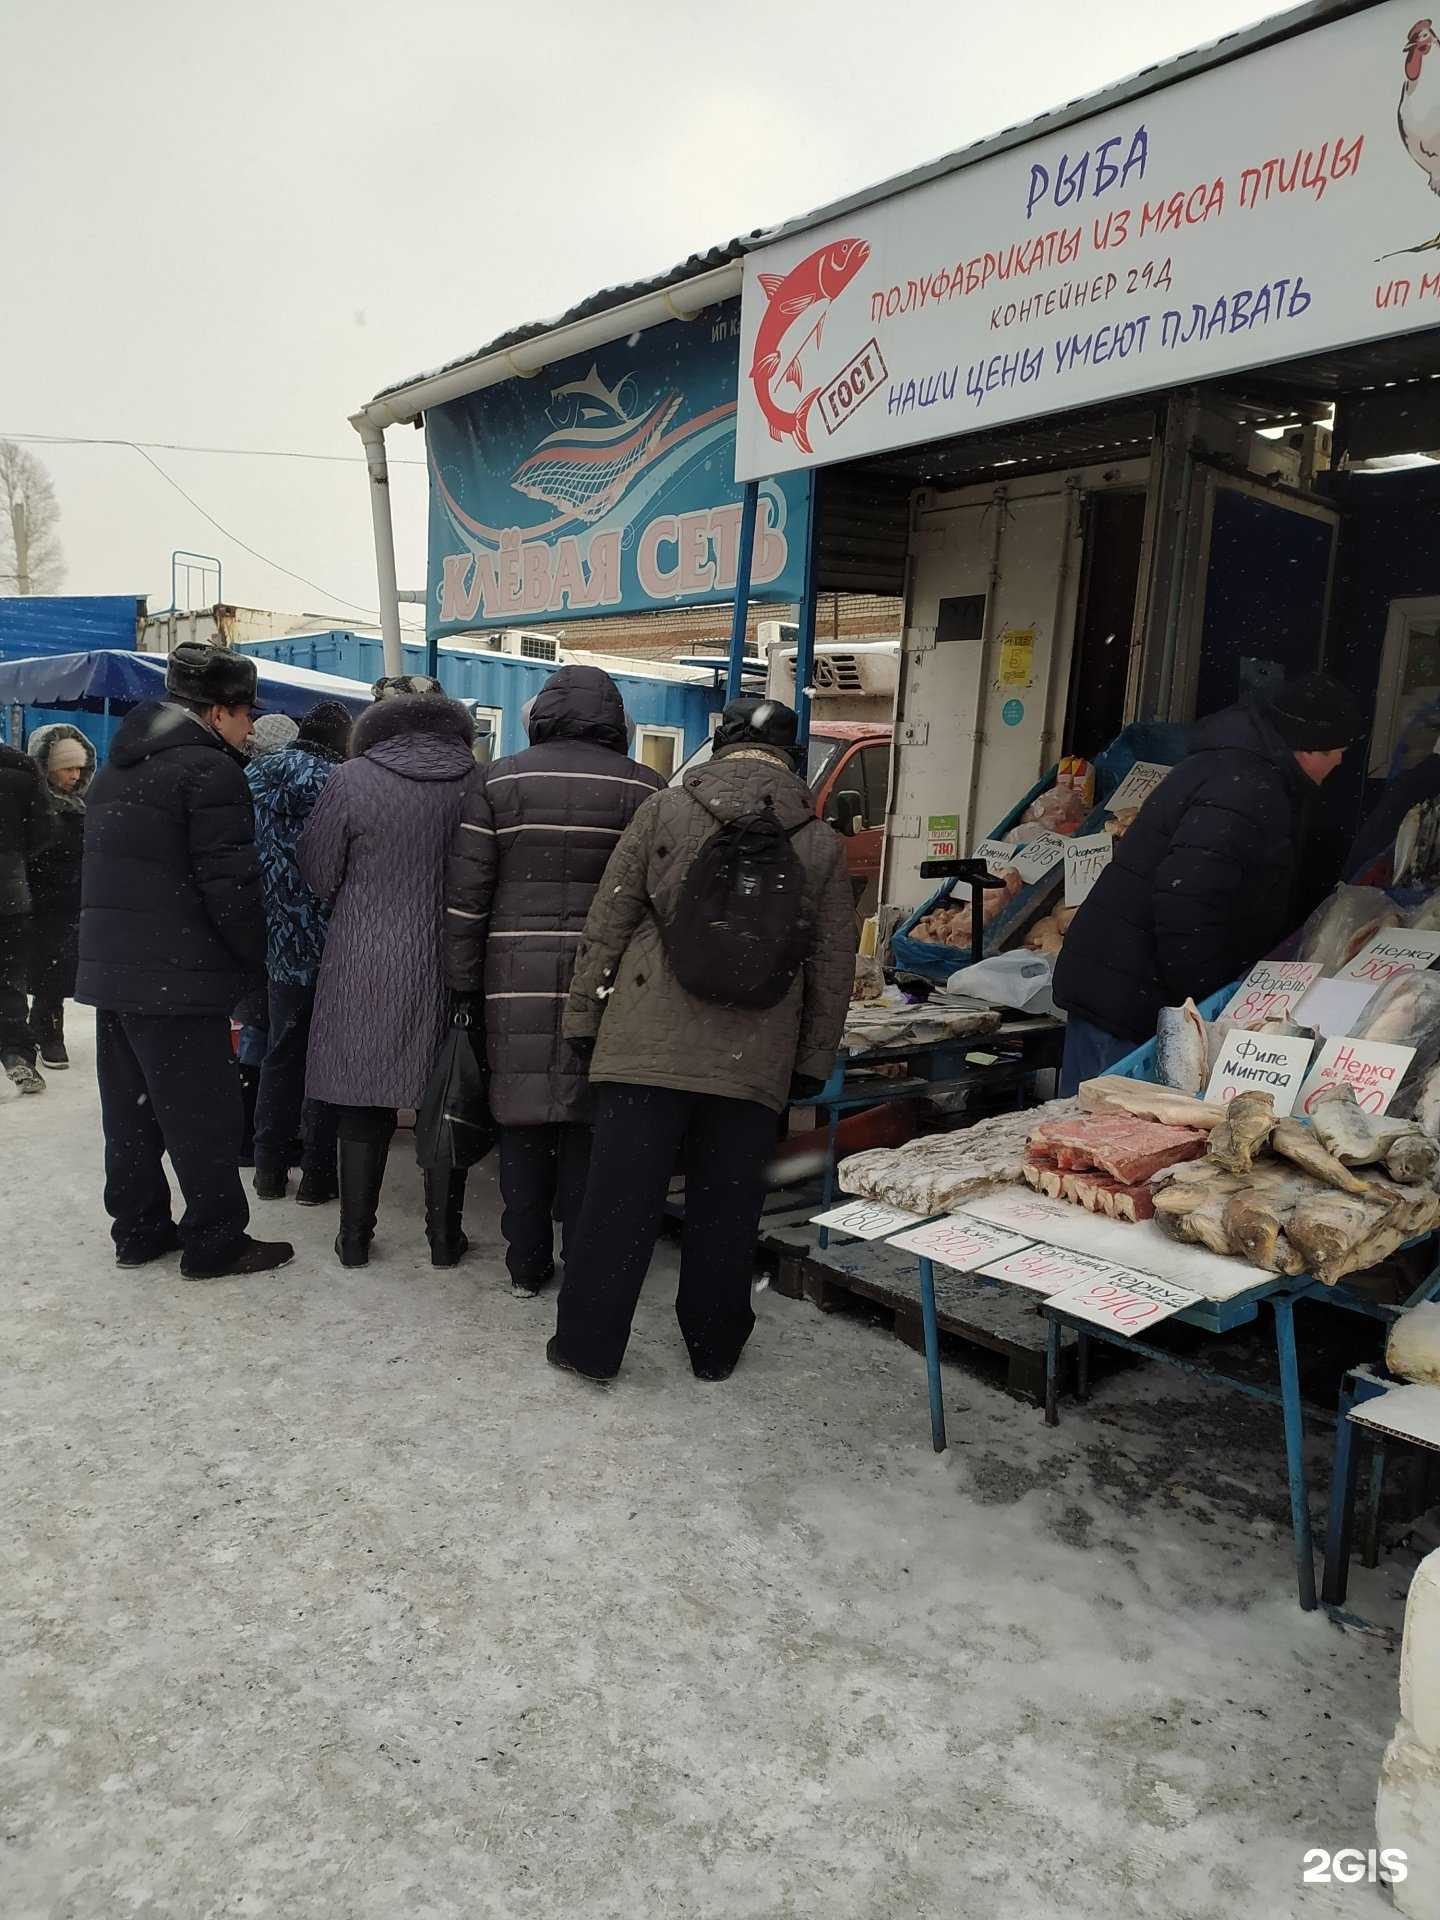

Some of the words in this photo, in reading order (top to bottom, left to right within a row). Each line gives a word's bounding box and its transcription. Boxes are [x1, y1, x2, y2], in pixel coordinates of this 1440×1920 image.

[1026, 125, 1148, 219] РЫБА
[871, 226, 1081, 327] ПОЛУФАБРИКАТЫ
[1093, 209, 1131, 250] ИЗ
[1139, 176, 1224, 238] МЯСА
[1239, 134, 1364, 210] ПТИЦЫ
[990, 272, 1117, 330] КОНТЕЙНЕР
[1126, 257, 1172, 294] 29Д
[1376, 280, 1410, 309] ИП
[1419, 271, 1440, 300] М
[888, 364, 958, 416] НАШИ
[966, 346, 1044, 407] ЦЕНЫ
[1055, 315, 1150, 374] УМЕЮТ
[1162, 276, 1311, 349] ПЛАВАТЬ
[828, 354, 875, 418] ГОСТ
[437, 526, 623, 621] КЛЁВАЯ
[637, 497, 788, 600] СЕТЬ
[1370, 943, 1436, 960] Нерка
[1246, 967, 1306, 997] Форель
[1236, 1039, 1288, 1067] Филе
[1333, 1045, 1396, 1080] Нерка
[1222, 1059, 1291, 1088] Минтая
[833, 1208, 895, 1232] 180
[1108, 1270, 1191, 1307] Терпуг
